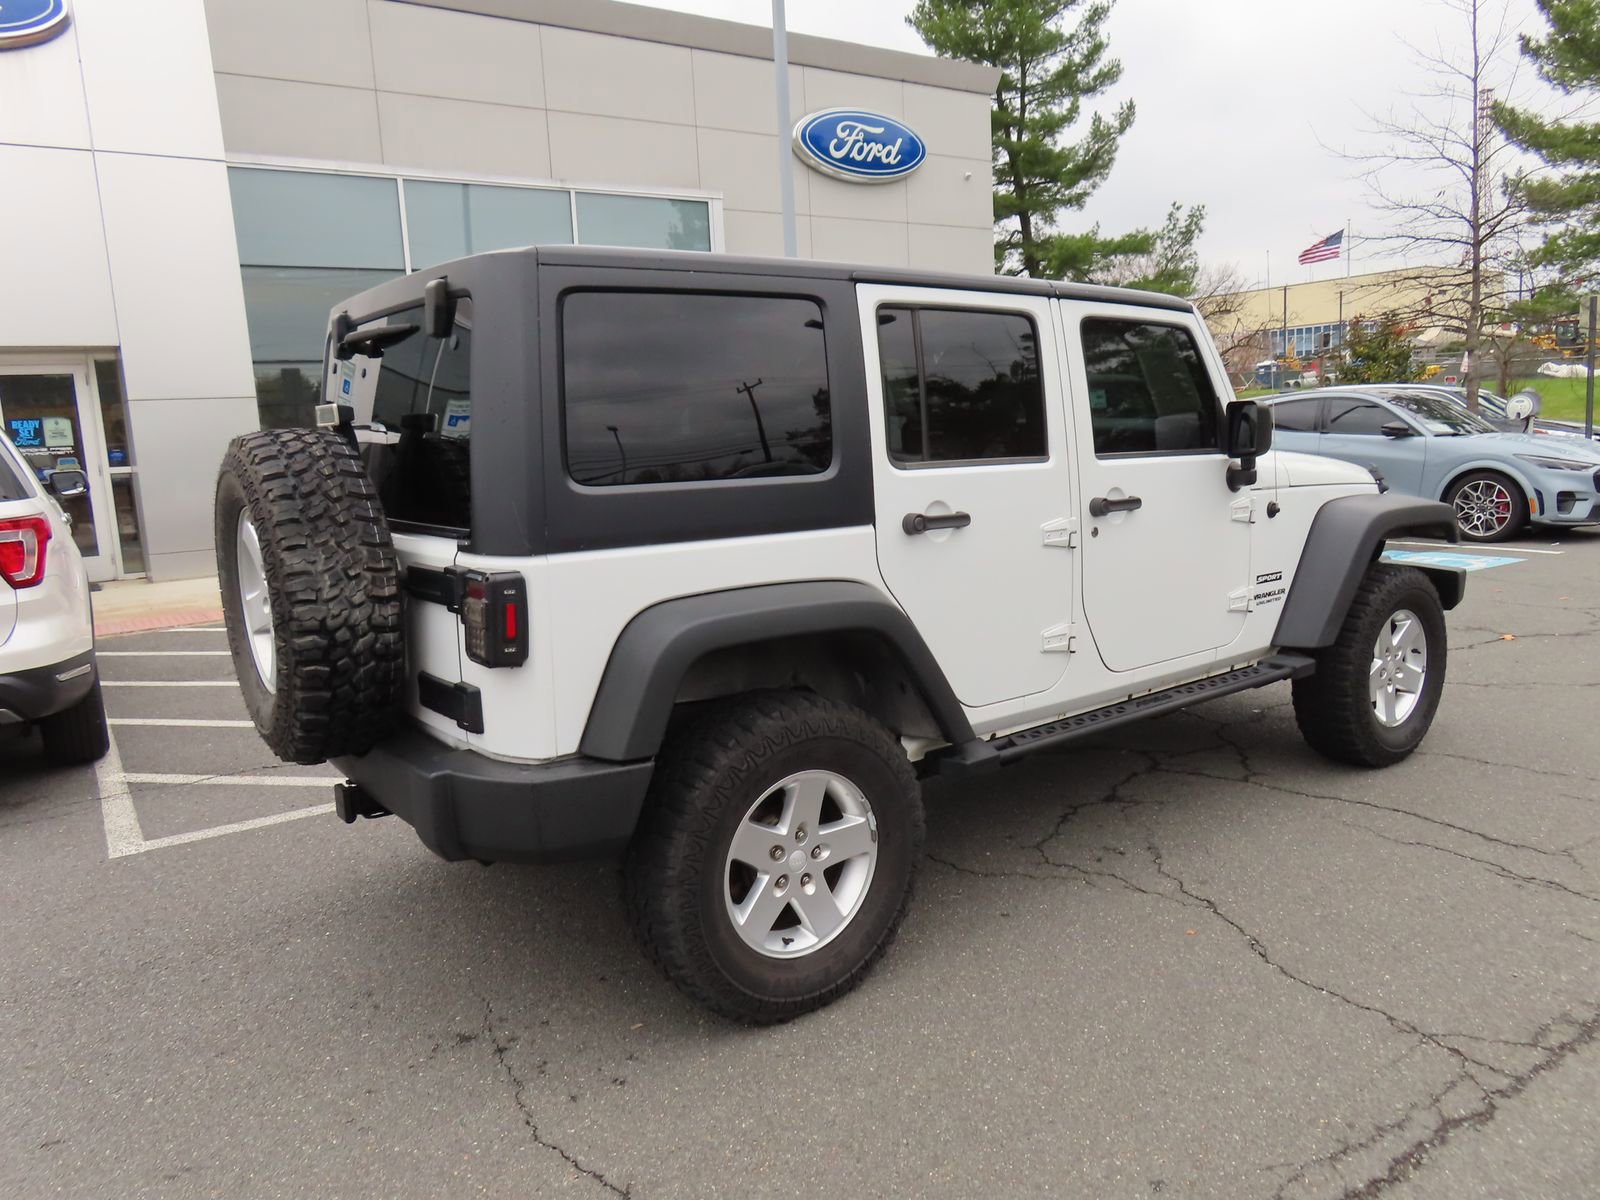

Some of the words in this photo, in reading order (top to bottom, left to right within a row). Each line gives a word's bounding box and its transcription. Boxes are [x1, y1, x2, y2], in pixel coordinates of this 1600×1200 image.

[829, 121, 902, 165] Ford
[11, 420, 40, 429] READY
[18, 428, 34, 437] SET
[15, 437, 41, 446] Ford
[1257, 572, 1282, 583] SPORT
